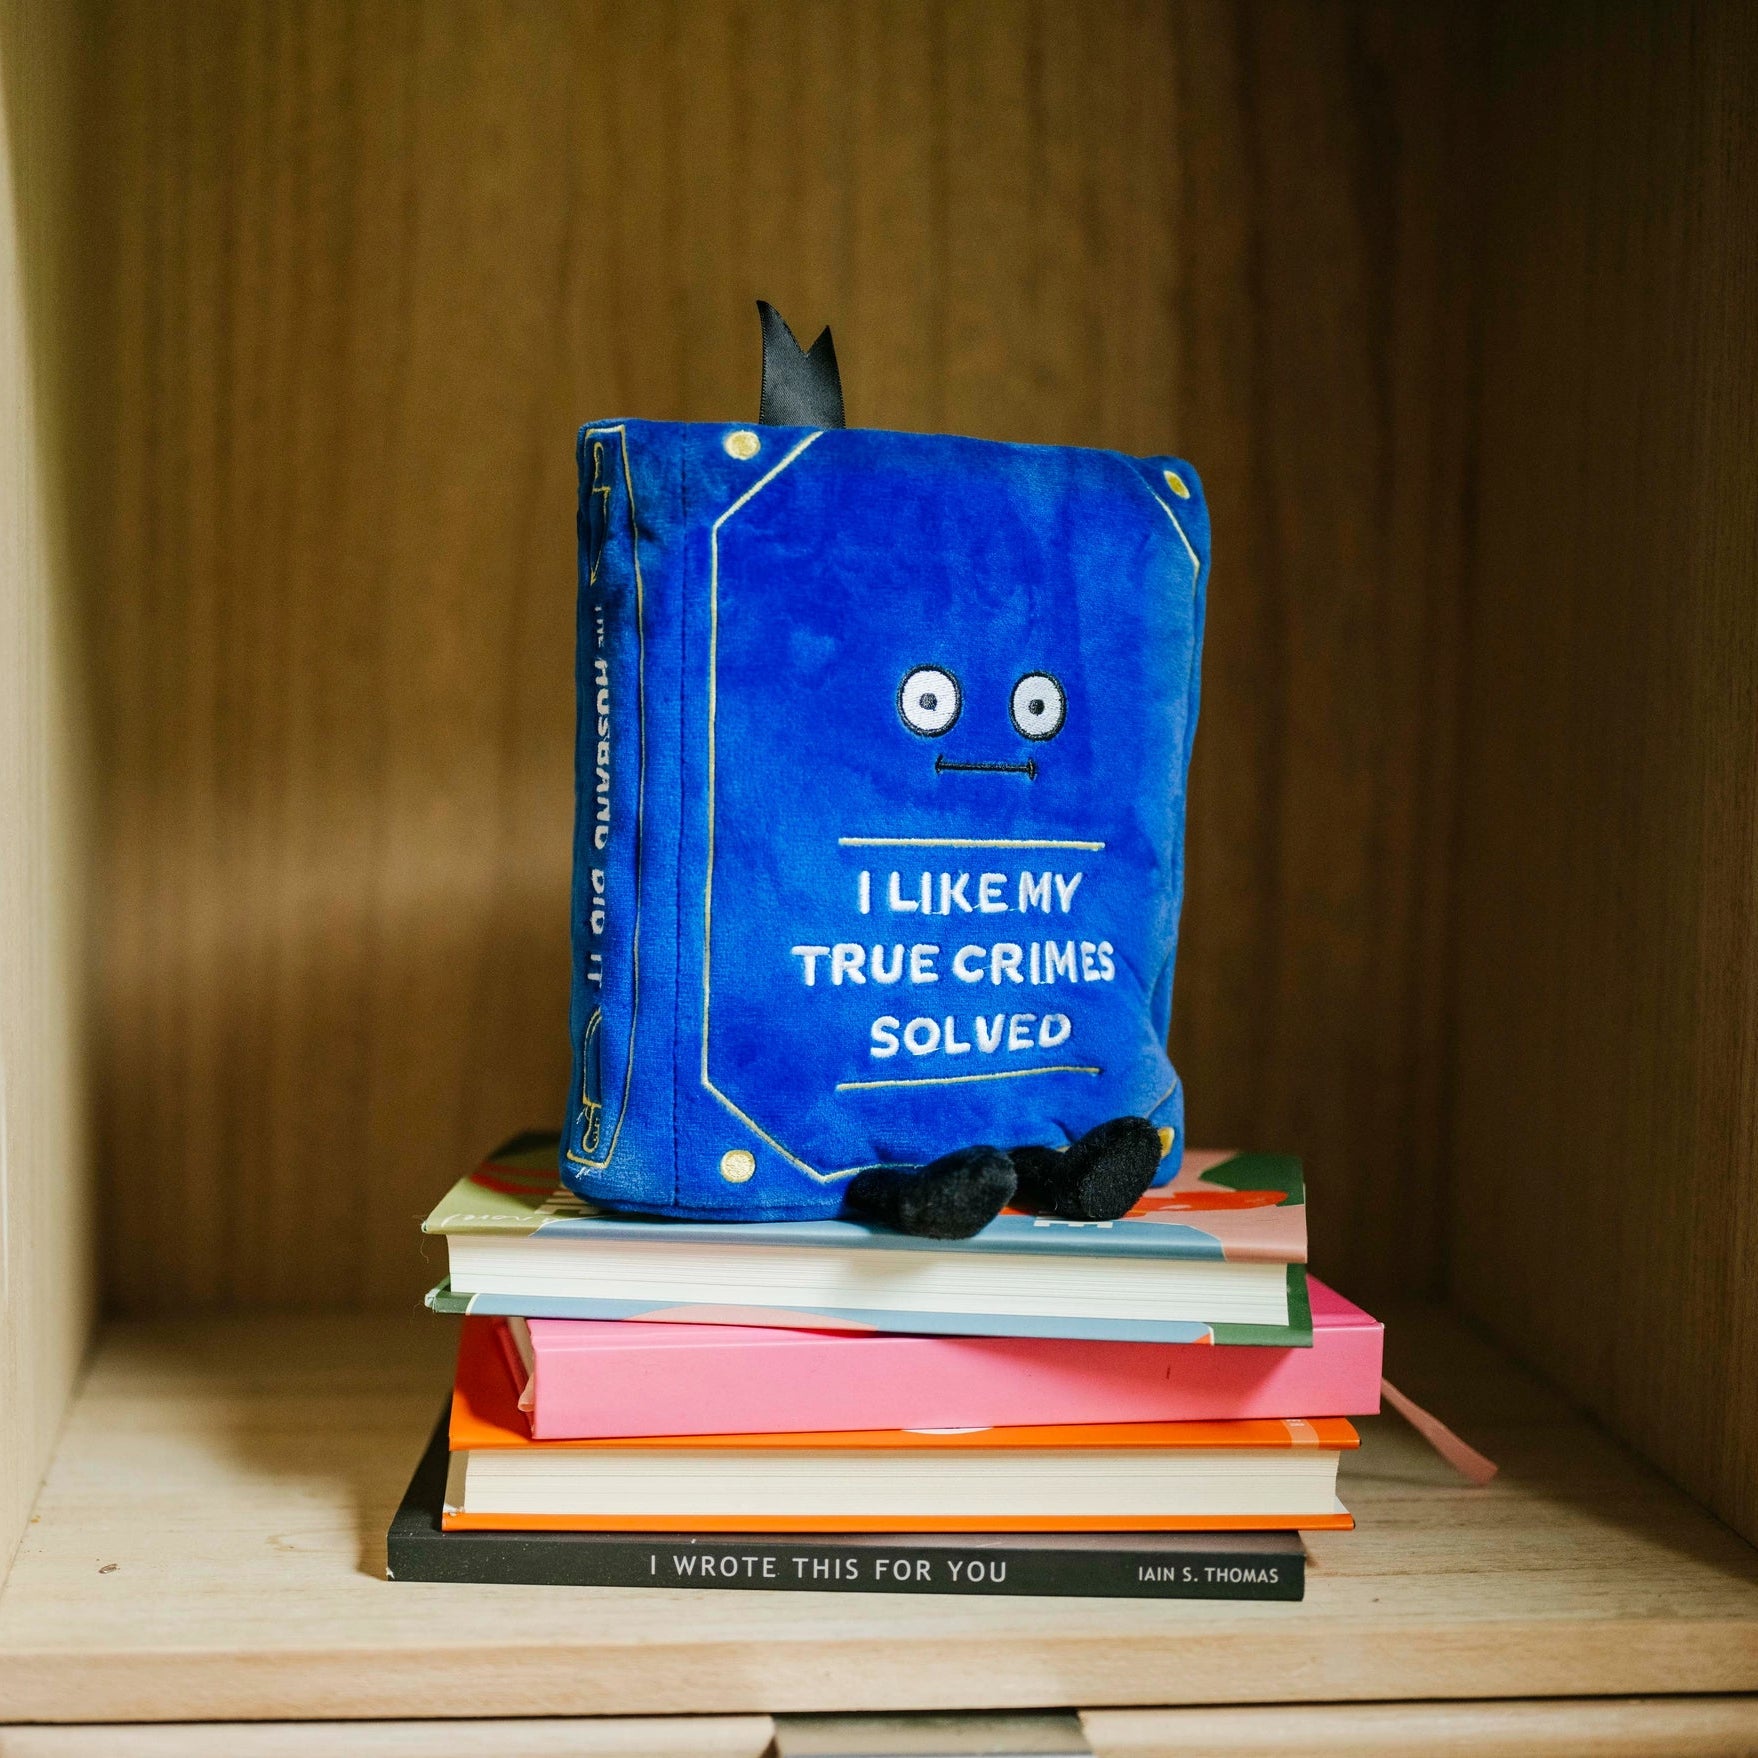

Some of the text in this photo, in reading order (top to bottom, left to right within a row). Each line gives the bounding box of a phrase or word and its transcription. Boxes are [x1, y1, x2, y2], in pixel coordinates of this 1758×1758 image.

[595, 658, 610, 849] HUSBAND
[590, 869, 605, 934] DID
[859, 871, 1083, 915] I LIKE MY
[588, 955, 602, 988] IT
[792, 941, 1114, 986] TRUE CRIMES
[871, 1014, 1071, 1058] SOLVED
[650, 1554, 1005, 1582] I WROTE THIS FOR YOU
[1139, 1567, 1278, 1583] IAIN S. THOMAS
